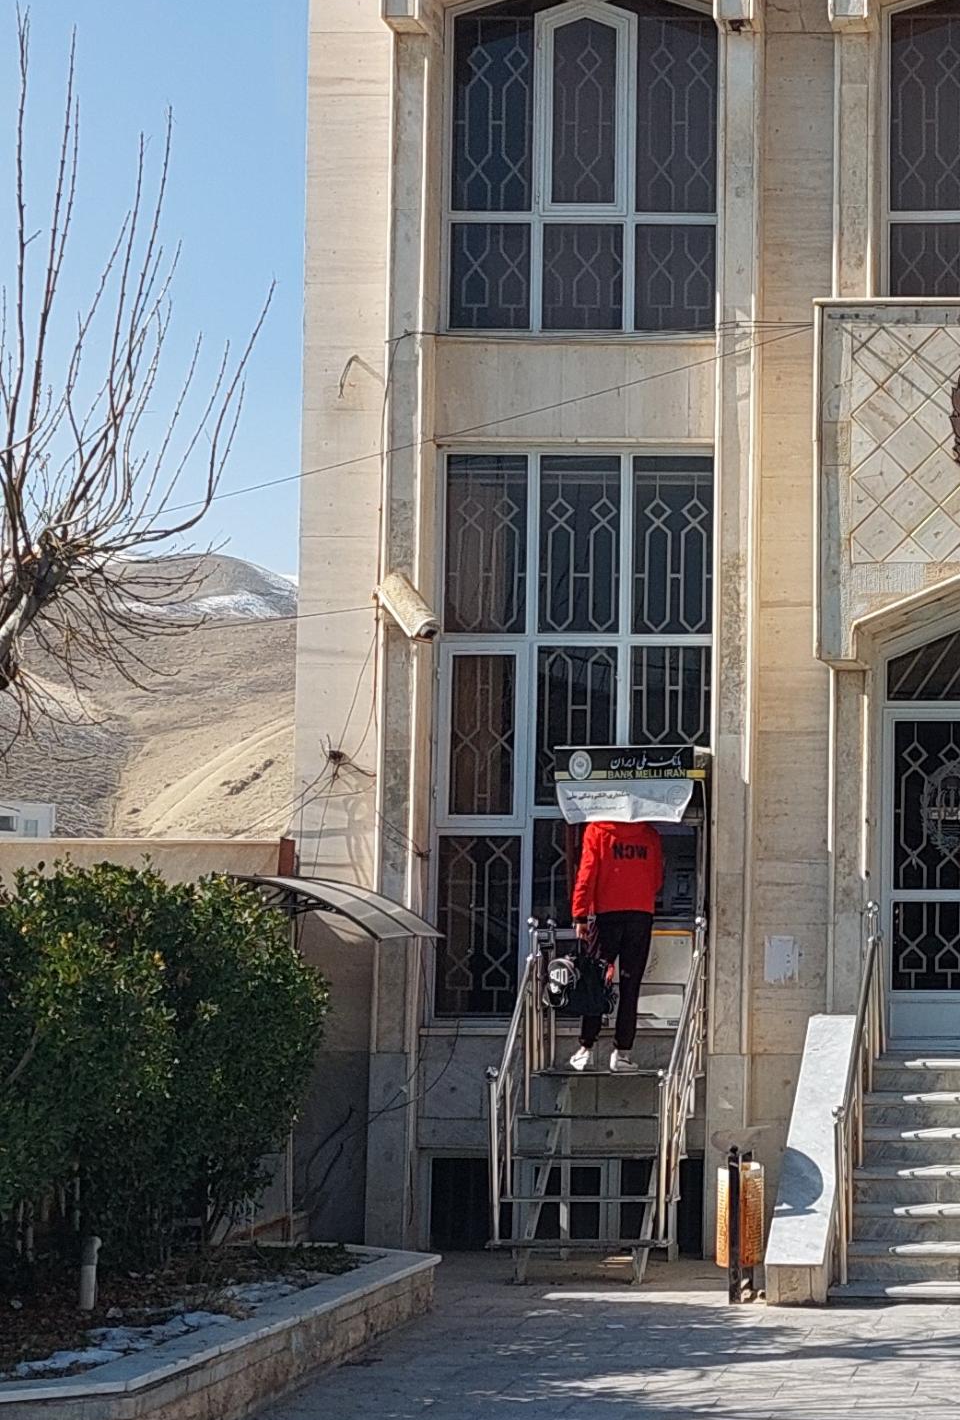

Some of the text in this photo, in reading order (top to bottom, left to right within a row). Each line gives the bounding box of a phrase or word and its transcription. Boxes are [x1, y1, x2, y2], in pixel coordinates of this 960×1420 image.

[607, 768, 686, 779] BANK MELLI IRAN
